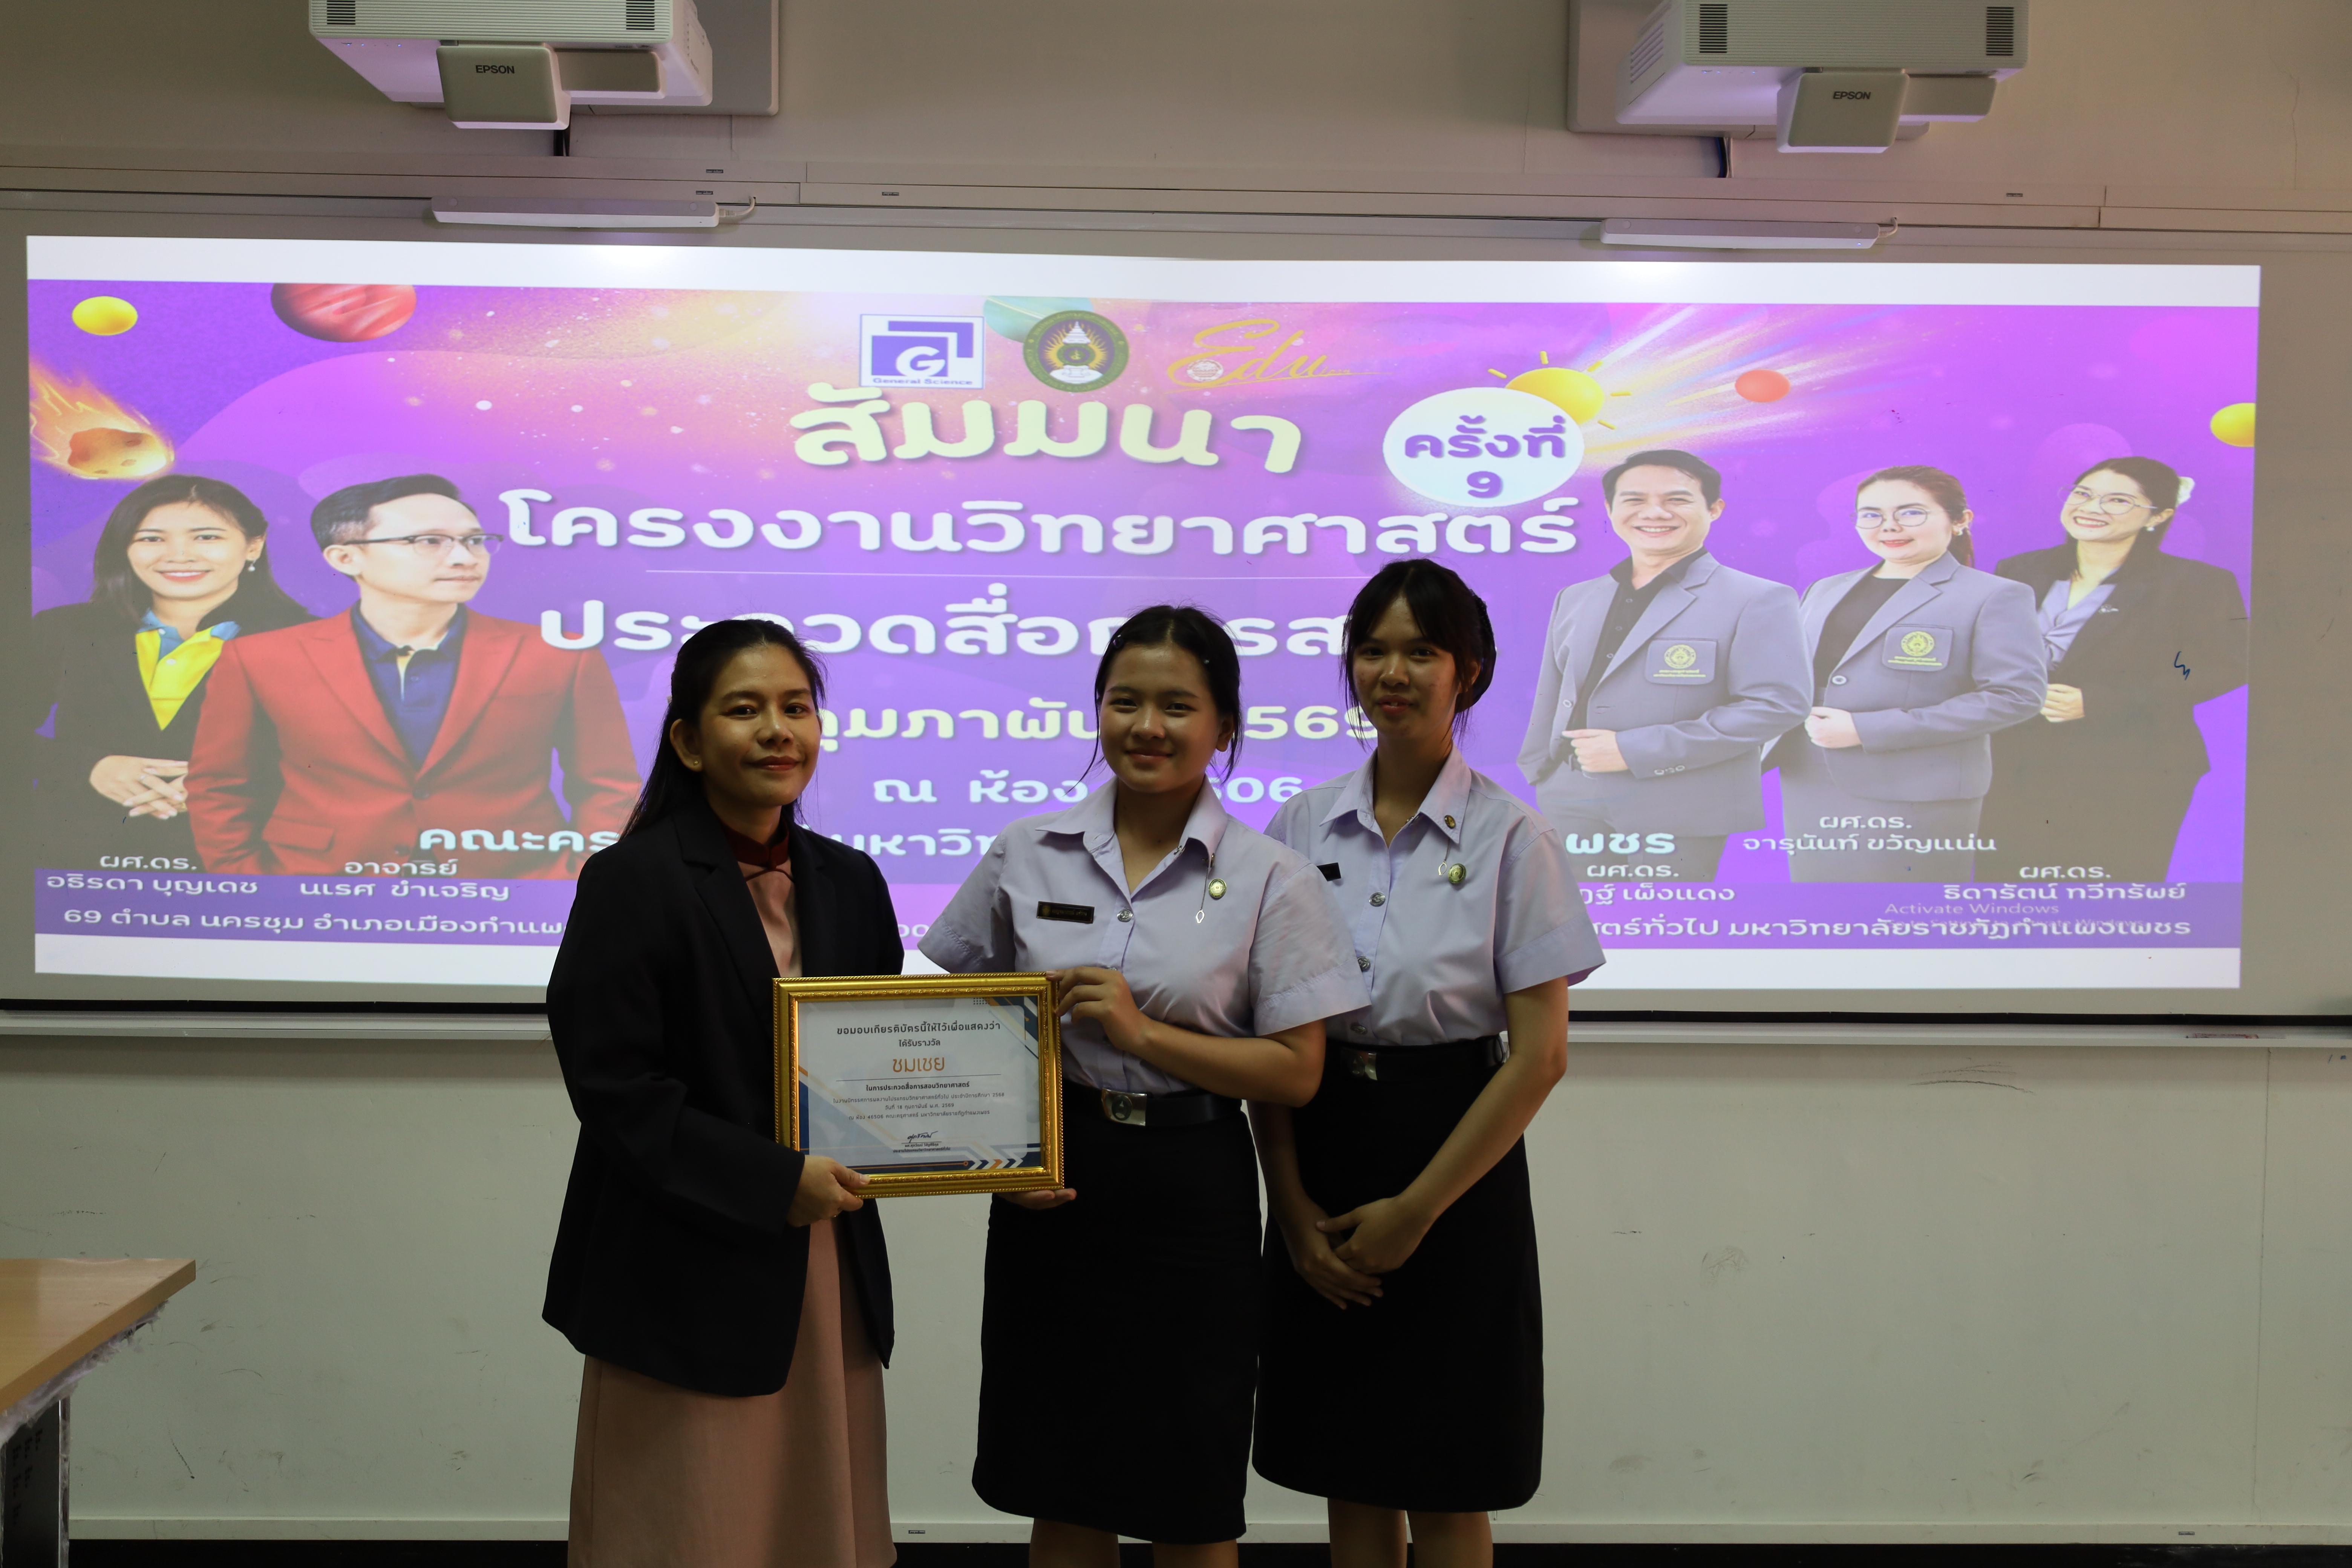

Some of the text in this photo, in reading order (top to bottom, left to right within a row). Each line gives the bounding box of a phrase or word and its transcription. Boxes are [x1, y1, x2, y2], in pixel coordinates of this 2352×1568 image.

[475, 64, 515, 74] EPSON
[1833, 91, 1871, 100] EPSON
[1167, 319, 1328, 387] Edu
[790, 382, 1301, 473] สัมมนา
[1404, 415, 1566, 458] ครั้งที่
[1466, 470, 1503, 498] 9
[499, 488, 1579, 554] โครงงานวิทยาศาสตร์
[873, 779, 938, 803] ณ
[969, 769, 1089, 803] ห้อง
[1819, 815, 1912, 829] ผศ.ดร.
[1565, 833, 1676, 854] พชร
[1743, 833, 1997, 855] จารุนันท์ ขวัญแน่น
[100, 855, 197, 870] ผศ.ดร.
[345, 859, 458, 876] อาจารย์
[1587, 865, 1680, 877] ผศ.ดร.
[2020, 865, 2111, 879] ผศ.ดร.
[47, 873, 144, 890] อธิรดา
[153, 879, 258, 896] บุญเดช
[300, 883, 376, 896] นเรศ
[391, 880, 510, 902] ขำเจริญ
[1623, 883, 1736, 901] เพ็งแดง
[1943, 883, 2058, 900] ธิดารัตน์
[2066, 882, 2187, 900] ทวีทรัพย์
[1885, 903, 2060, 914] Activate Windows
[64, 909, 102, 923] 69
[111, 908, 190, 926] ตำบล
[201, 914, 304, 934] นครชุม
[314, 913, 567, 934] อำเภอเมืองกำแพ
[837, 1020, 1001, 1035] ขอมอบเกียรติบัตรนี้ให้ไว้เพื่อแสดงว่า
[899, 1038, 941, 1047] ได้รับรางวัล
[893, 1057, 945, 1073] ชมเชย
[866, 1081, 970, 1091] ในการประกวดสื่อการสอนวิทยาศาสตร์
